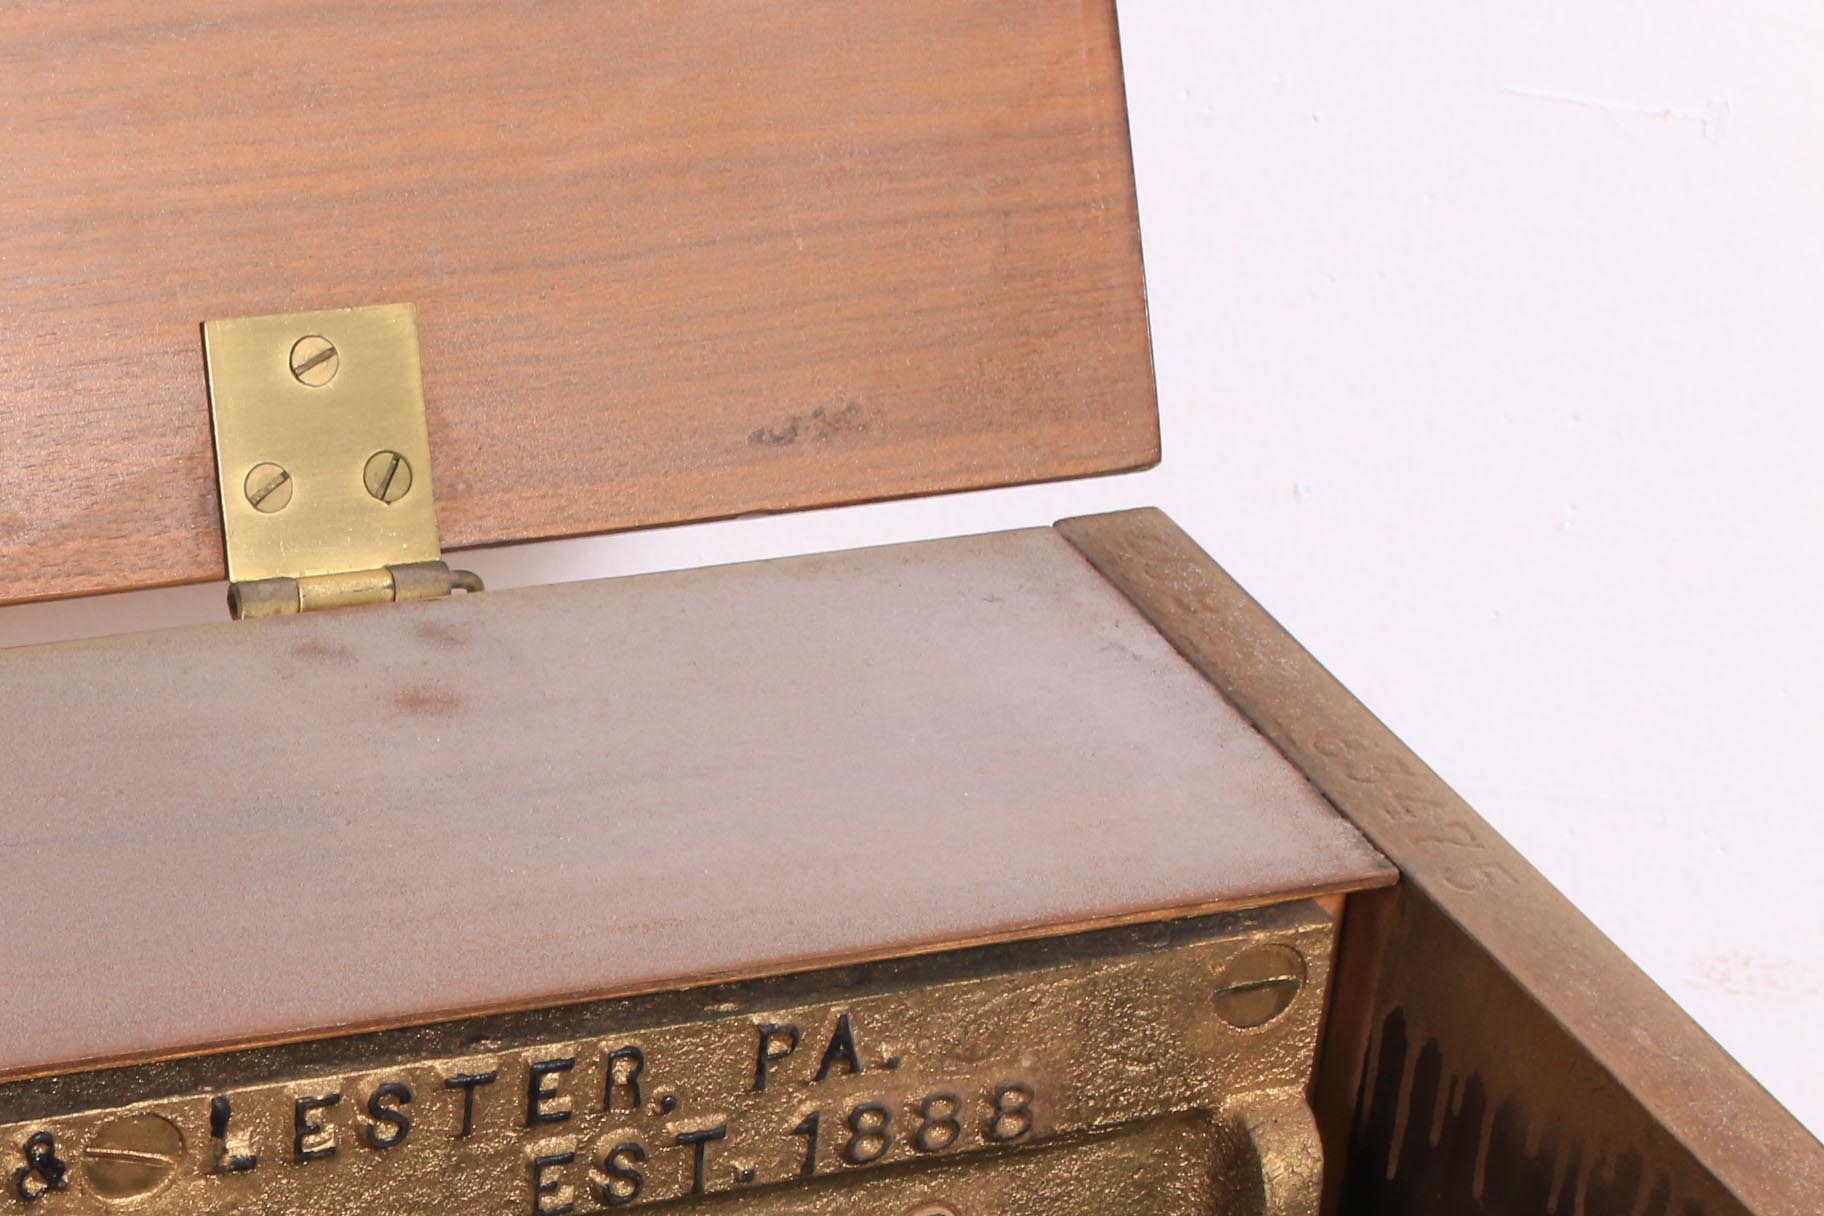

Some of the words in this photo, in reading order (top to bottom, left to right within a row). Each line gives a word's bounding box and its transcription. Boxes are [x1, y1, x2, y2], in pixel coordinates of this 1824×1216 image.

[13, 1130, 68, 1201] &
[531, 1124, 756, 1216] EST.
[790, 1081, 1036, 1176] 1888
